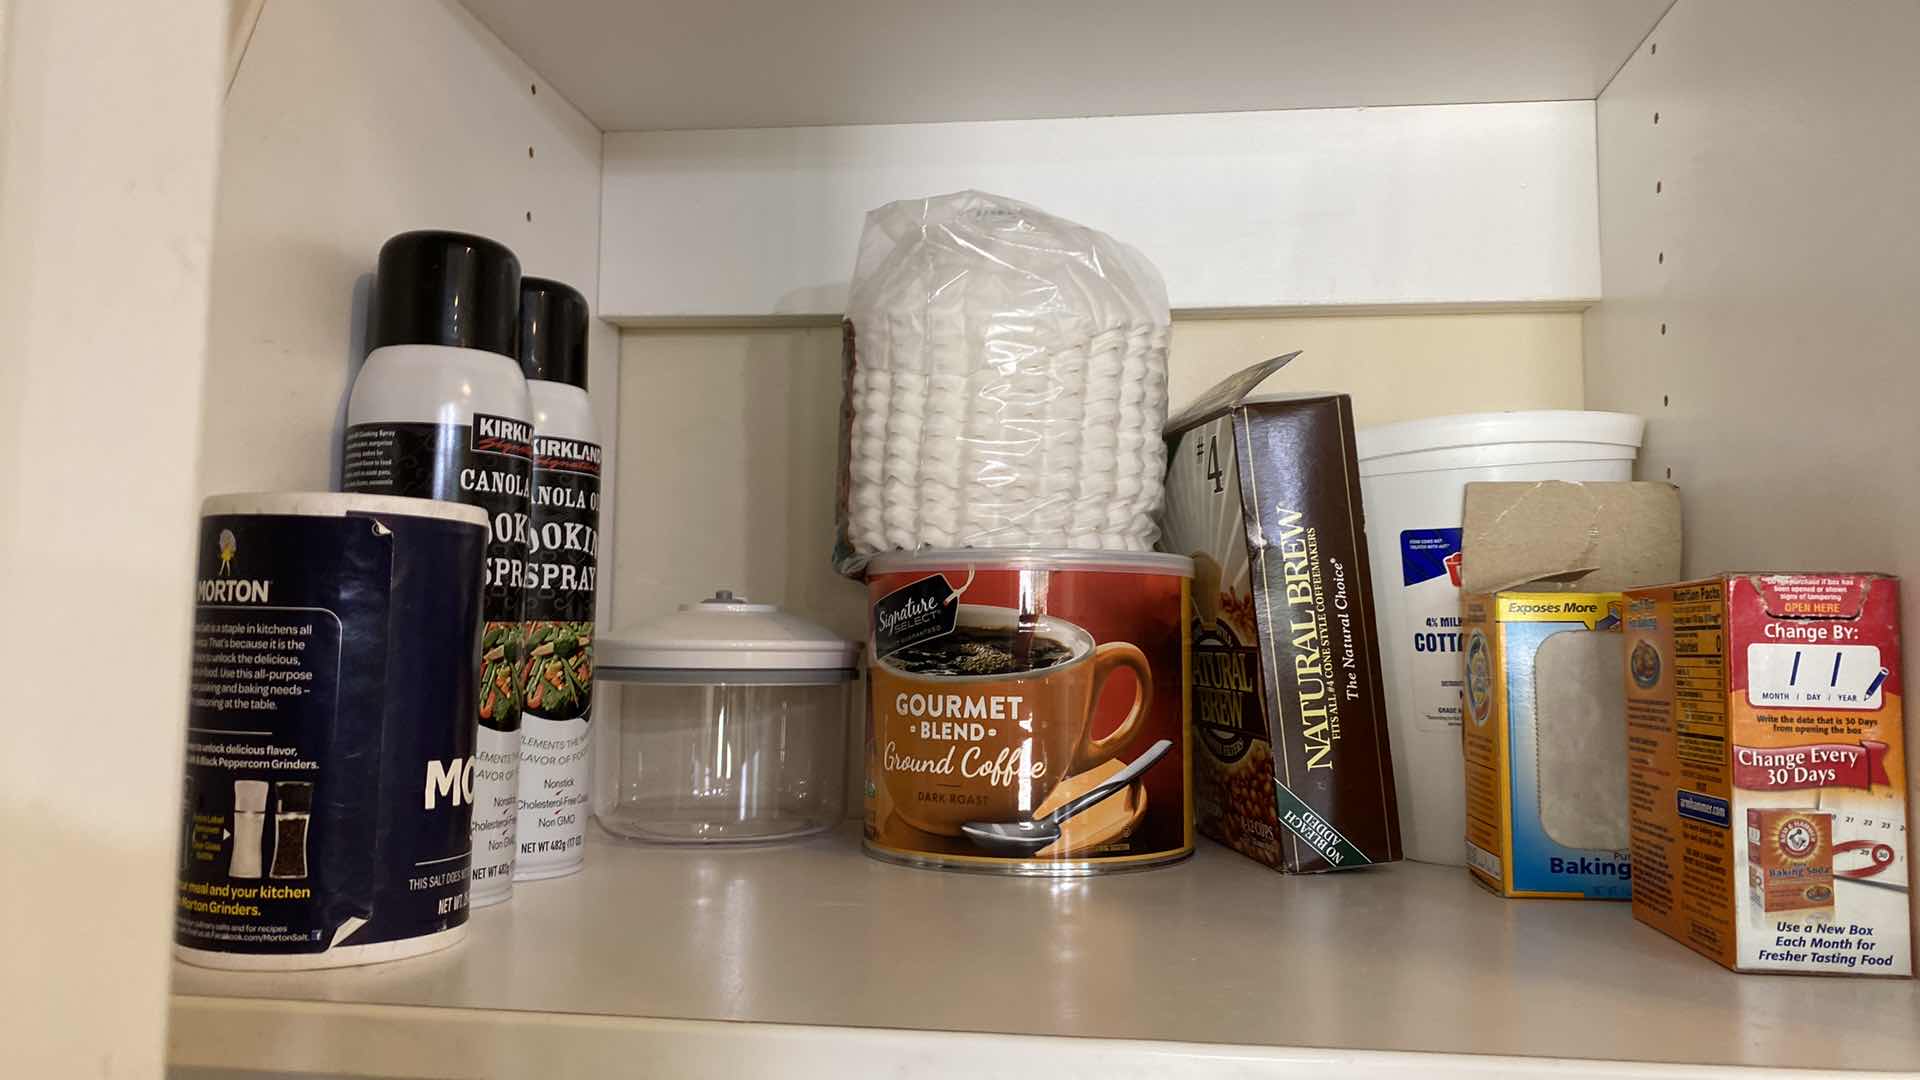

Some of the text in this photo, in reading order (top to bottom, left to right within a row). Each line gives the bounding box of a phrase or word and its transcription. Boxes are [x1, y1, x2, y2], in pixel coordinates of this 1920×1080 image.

[527, 563, 596, 591] SPRAY
[1306, 527, 1326, 612] COFFEEMAKERS
[1508, 602, 1597, 615] Exposes More
[1784, 602, 1841, 613] OPEN HERE
[879, 597, 938, 637] Signature
[1426, 617, 1438, 627] 4%
[247, 624, 256, 634] in
[257, 624, 298, 636] kitchens
[299, 624, 312, 635] all
[1276, 501, 1333, 772] NATURAL BREW
[1318, 613, 1330, 647] STYLE
[1764, 622, 1828, 642] Change
[229, 639, 268, 649] because
[269, 640, 276, 649] it
[277, 641, 286, 649] is
[287, 640, 305, 650] the
[1338, 613, 1356, 669] Natural
[238, 654, 253, 664] the
[254, 654, 301, 666] delicious,
[1322, 648, 1334, 679] CONE
[237, 668, 253, 679] this
[254, 669, 313, 682] all-purpose
[221, 683, 237, 693] and
[238, 684, 269, 697] baking
[270, 685, 302, 695] needs
[1346, 672, 1360, 702] The
[234, 699, 250, 709] the
[1327, 694, 1338, 715] ALL
[1762, 692, 1857, 702] MONTH DAY YEAR
[896, 692, 1023, 720] GOURMET
[1330, 716, 1341, 741] FITS
[1757, 715, 1777, 724] Write
[1780, 715, 1795, 724] the
[1797, 716, 1815, 725] date
[1816, 716, 1834, 726] that
[1836, 717, 1843, 725] is
[1858, 718, 1878, 728] Days
[921, 721, 985, 741] BLEND
[1773, 724, 1862, 736] from opening the box
[226, 744, 265, 755] delicious
[266, 745, 298, 757] flavor,
[218, 757, 320, 770] Peppercorn Grinders.
[884, 741, 1047, 787] Ground Coffe
[1738, 747, 1858, 771] Change Every
[544, 777, 575, 789] Nonstick
[1768, 767, 1836, 786] 30 Days
[918, 791, 990, 807] DARK ROAST
[538, 814, 575, 828] Non GMO
[1845, 816, 1854, 824] 21
[1284, 810, 1328, 851] BLEACH
[1302, 812, 1342, 846] ADDED
[488, 840, 503, 851] Non
[521, 842, 536, 854] NET
[538, 841, 549, 852] WT
[1326, 846, 1344, 864] NO
[472, 867, 486, 881] NET
[487, 866, 498, 877] WT
[1550, 857, 1632, 880] Baking
[409, 878, 428, 891] THIS
[429, 874, 446, 888] SALT
[209, 884, 230, 897] and
[231, 888, 258, 900] your
[260, 885, 311, 899] kitchen
[209, 901, 262, 916] Grinders.
[438, 897, 453, 915] NET
[245, 924, 257, 933] for
[258, 925, 288, 934] recipes
[1777, 922, 1874, 936] Use a New Box
[1776, 936, 1877, 951] Each Month for
[1759, 950, 1894, 967] Fresher Tasting Food
